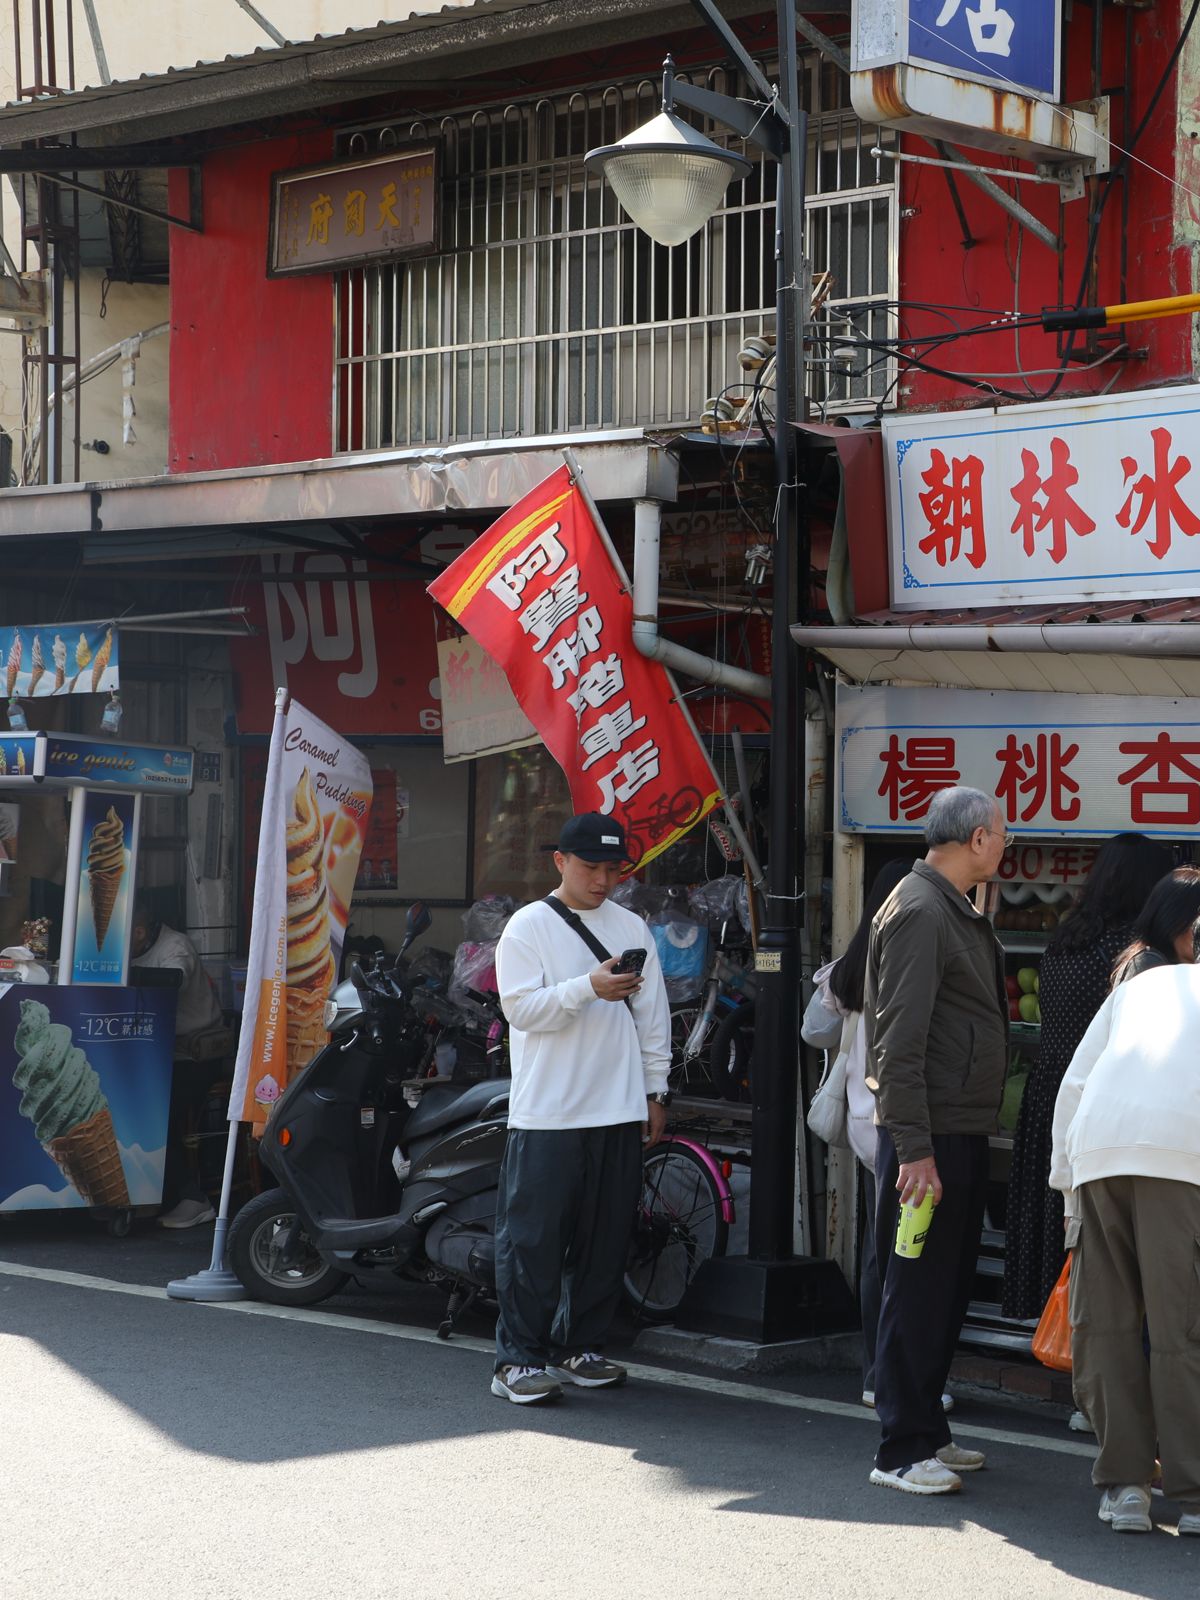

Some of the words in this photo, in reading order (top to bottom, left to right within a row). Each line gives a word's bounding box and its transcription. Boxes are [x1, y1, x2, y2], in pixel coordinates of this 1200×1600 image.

[48, 744, 80, 765] ice
[80, 751, 138, 773] genie
[284, 727, 340, 767] Caramel
[315, 772, 368, 818] Pudding
